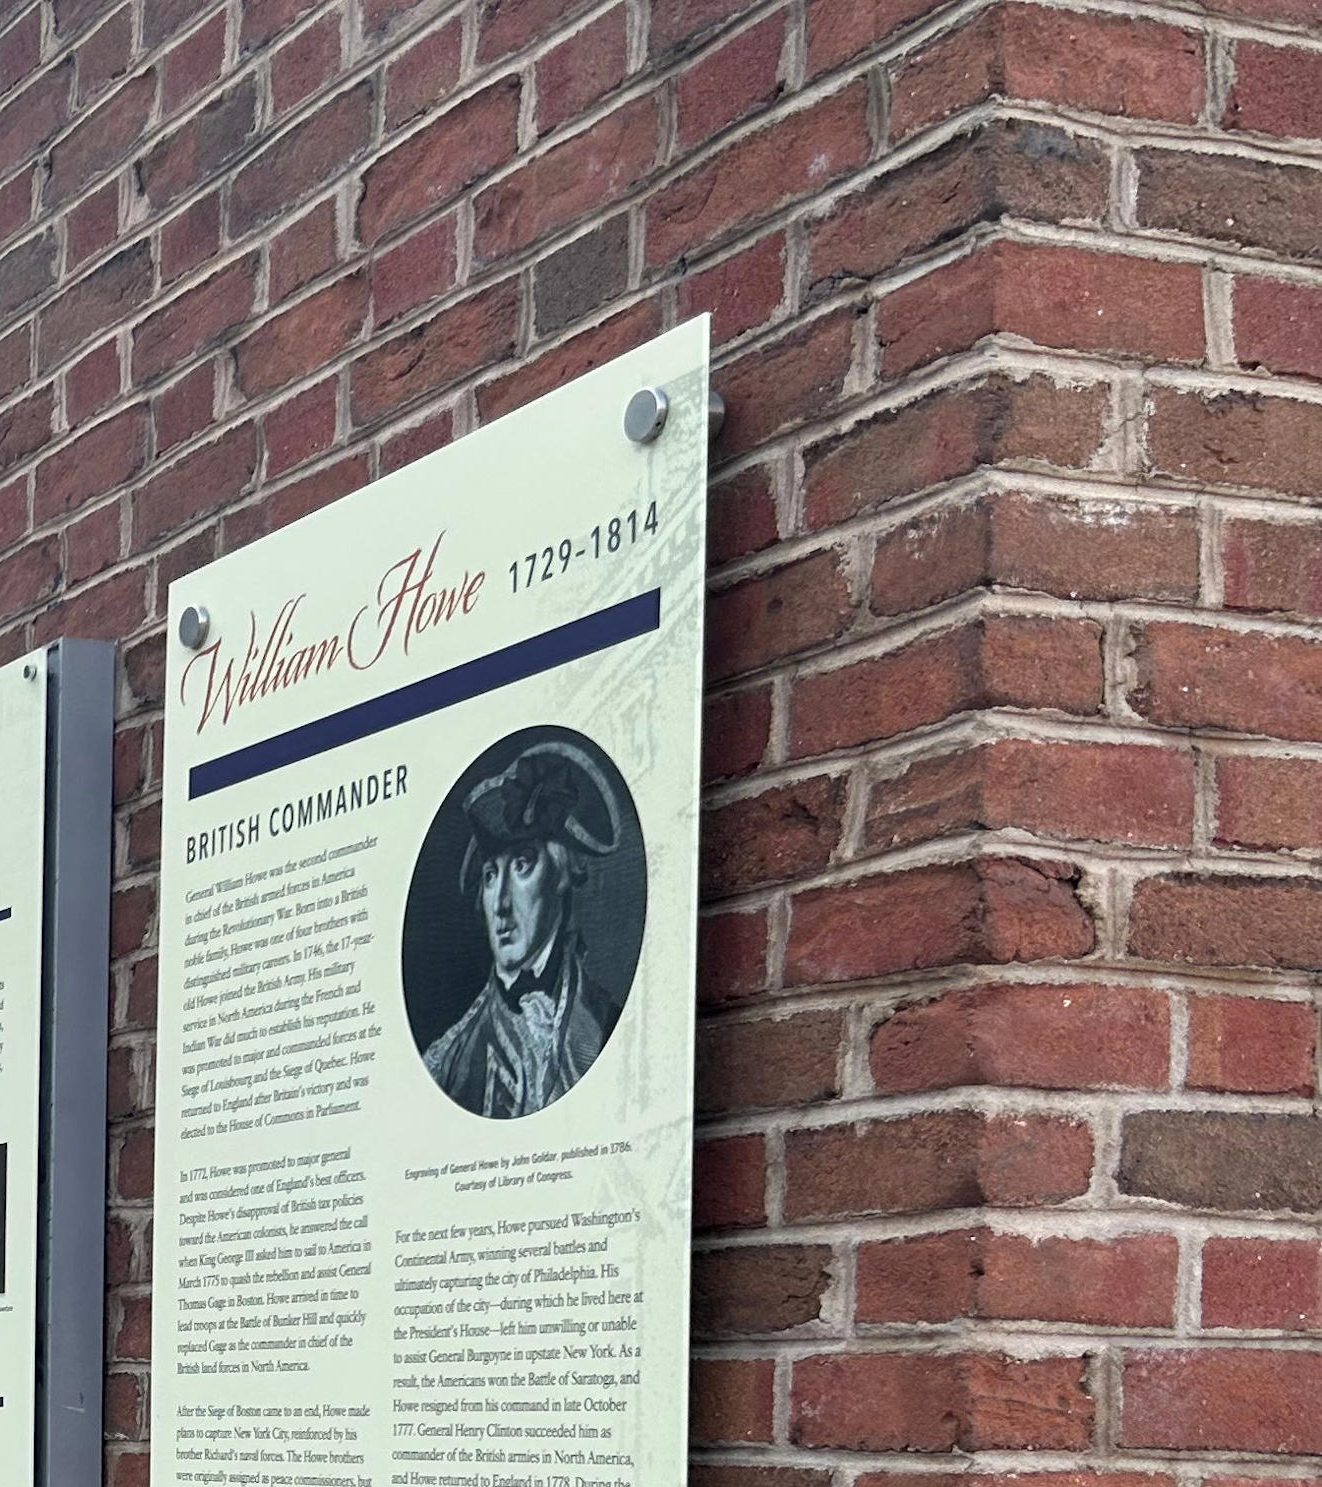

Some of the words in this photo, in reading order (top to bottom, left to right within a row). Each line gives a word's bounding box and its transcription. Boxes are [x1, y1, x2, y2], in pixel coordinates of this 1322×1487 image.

[181, 594, 344, 735] William
[347, 529, 485, 671] Howe
[508, 501, 659, 593] 1729-1814
[186, 813, 259, 864] BRITISH
[269, 764, 406, 836] COMMANDER
[395, 1229, 410, 1243] For
[411, 1229, 426, 1242] the
[427, 1228, 448, 1240] next
[450, 1223, 467, 1238] few
[496, 1219, 526, 1234] Howe
[527, 1213, 568, 1236] pursued
[570, 1207, 640, 1228] Washington's
[394, 1250, 447, 1267] Continental
[476, 1246, 516, 1263] winning
[517, 1241, 551, 1258] several
[552, 1239, 586, 1255] battles
[587, 1236, 607, 1252] and
[393, 1353, 402, 1363] to
[403, 1350, 427, 1363] assist
[428, 1348, 465, 1363] General
[466, 1348, 512, 1365] Burgoyne
[513, 1347, 523, 1360] in
[525, 1348, 561, 1364] upstate
[562, 1344, 587, 1359] New
[618, 1343, 633, 1357] As
[634, 1346, 641, 1357] a
[420, 1374, 435, 1387] the
[436, 1374, 485, 1387] Americans
[487, 1376, 508, 1386] won
[510, 1372, 525, 1386] the
[527, 1371, 556, 1386] Battle
[558, 1370, 570, 1385] of
[619, 1369, 640, 1384] and
[392, 1398, 419, 1412] Howe
[420, 1398, 458, 1415] resigned
[460, 1397, 483, 1411] from
[484, 1397, 499, 1411] his
[500, 1397, 549, 1411] command
[551, 1398, 561, 1411] in
[563, 1397, 581, 1411] late
[583, 1396, 627, 1411] October
[416, 1422, 453, 1436] General
[454, 1423, 485, 1440] Henry
[486, 1423, 523, 1437] Clinton
[524, 1423, 576, 1438] succeeded
[578, 1424, 598, 1438] him
[599, 1427, 611, 1438] as
[391, 1447, 445, 1461] commander
[446, 1447, 457, 1461] of
[458, 1448, 473, 1462] the
[475, 1448, 505, 1462] British
[507, 1449, 540, 1463] armies
[541, 1450, 551, 1463] in
[553, 1449, 585, 1464] North
[391, 1471, 408, 1484] and
[410, 1471, 437, 1485] Howe
[438, 1472, 479, 1487] returned
[479, 1476, 490, 1487] to
